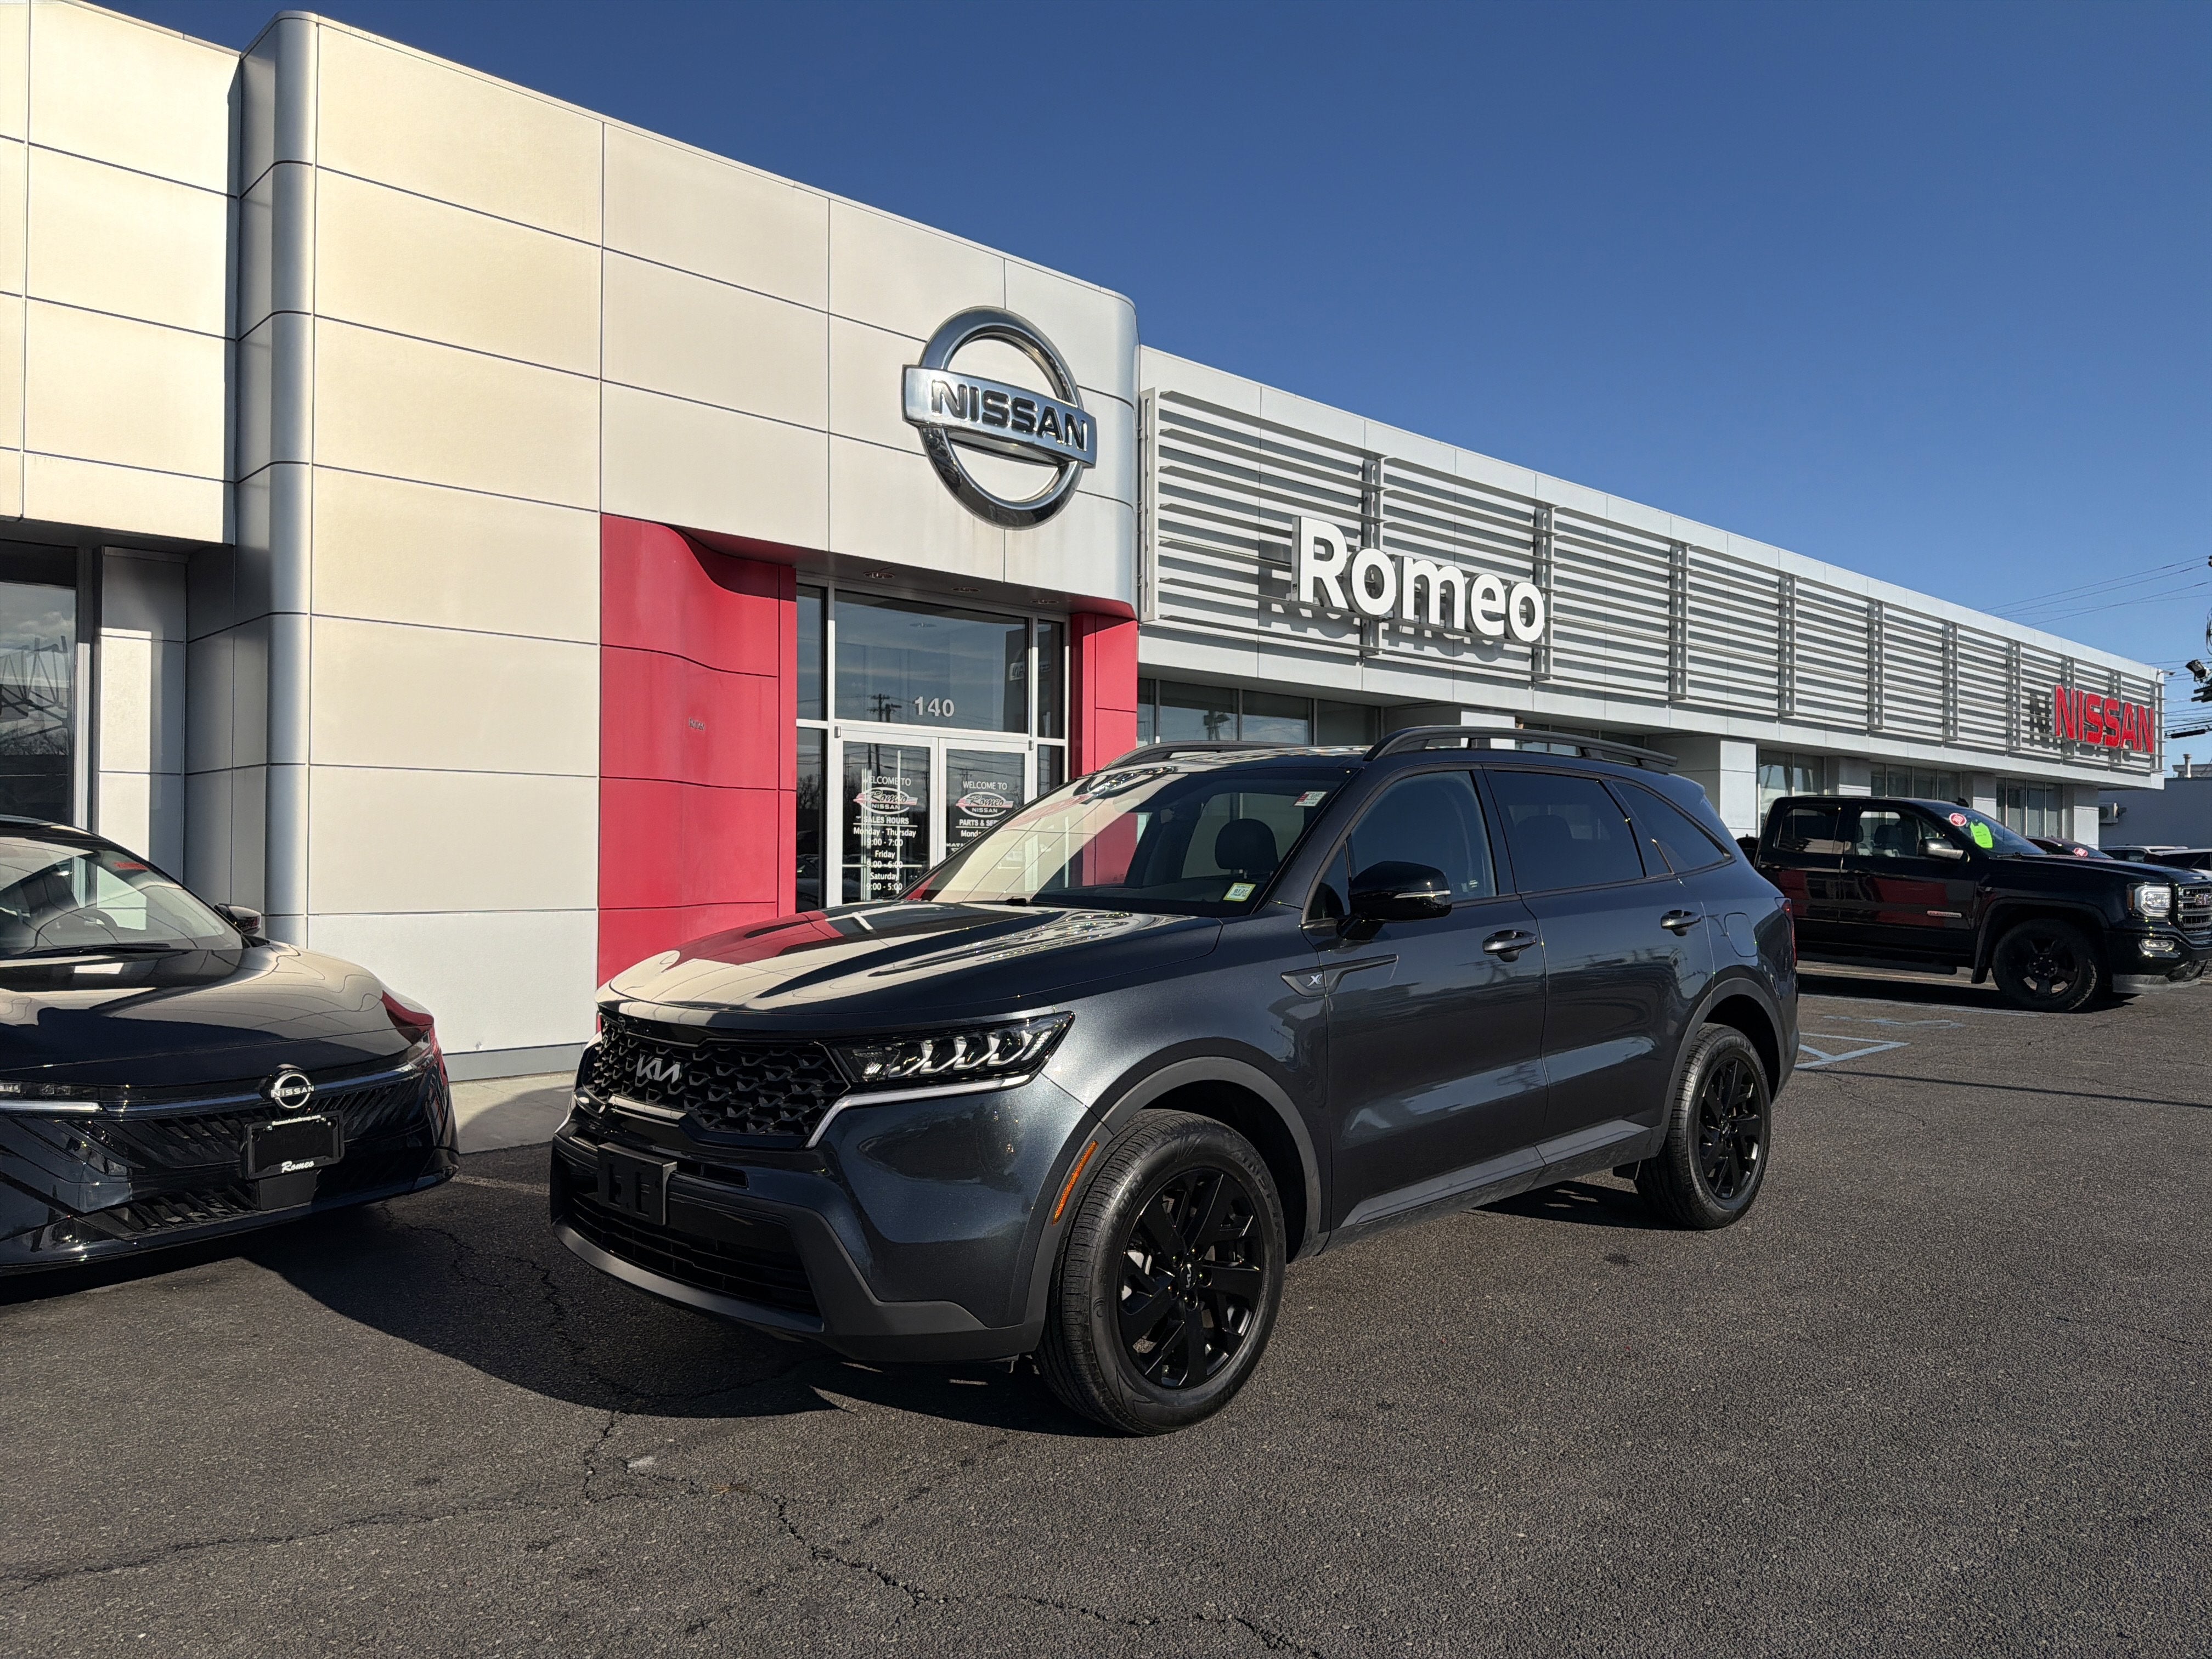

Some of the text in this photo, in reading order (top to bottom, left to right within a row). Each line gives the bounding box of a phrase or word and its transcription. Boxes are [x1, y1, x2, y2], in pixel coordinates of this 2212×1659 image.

[930, 379, 1088, 453] NISSAN
[1291, 516, 1545, 642] Romeo
[913, 696, 955, 718] 140
[2053, 684, 2155, 754] NISSAN
[863, 775, 911, 786] WELCOME TO
[963, 781, 996, 790] WELCOME
[967, 793, 1004, 806] Romeo
[864, 816, 910, 825] SALES HOURS
[853, 827, 881, 837] Monday
[885, 828, 917, 838] Thursday
[867, 838, 882, 846] 9:00
[888, 838, 904, 847] 7:00
[874, 850, 895, 859] Friday
[867, 860, 882, 868] 9:00
[888, 860, 903, 868] 6:00
[870, 872, 898, 882] Saturday
[866, 882, 882, 891] 9:00
[888, 882, 902, 891] 5:00
[636, 1056, 681, 1084] KIA
[272, 1085, 314, 1098] NISSAN
[281, 1160, 315, 1173] Romeo
